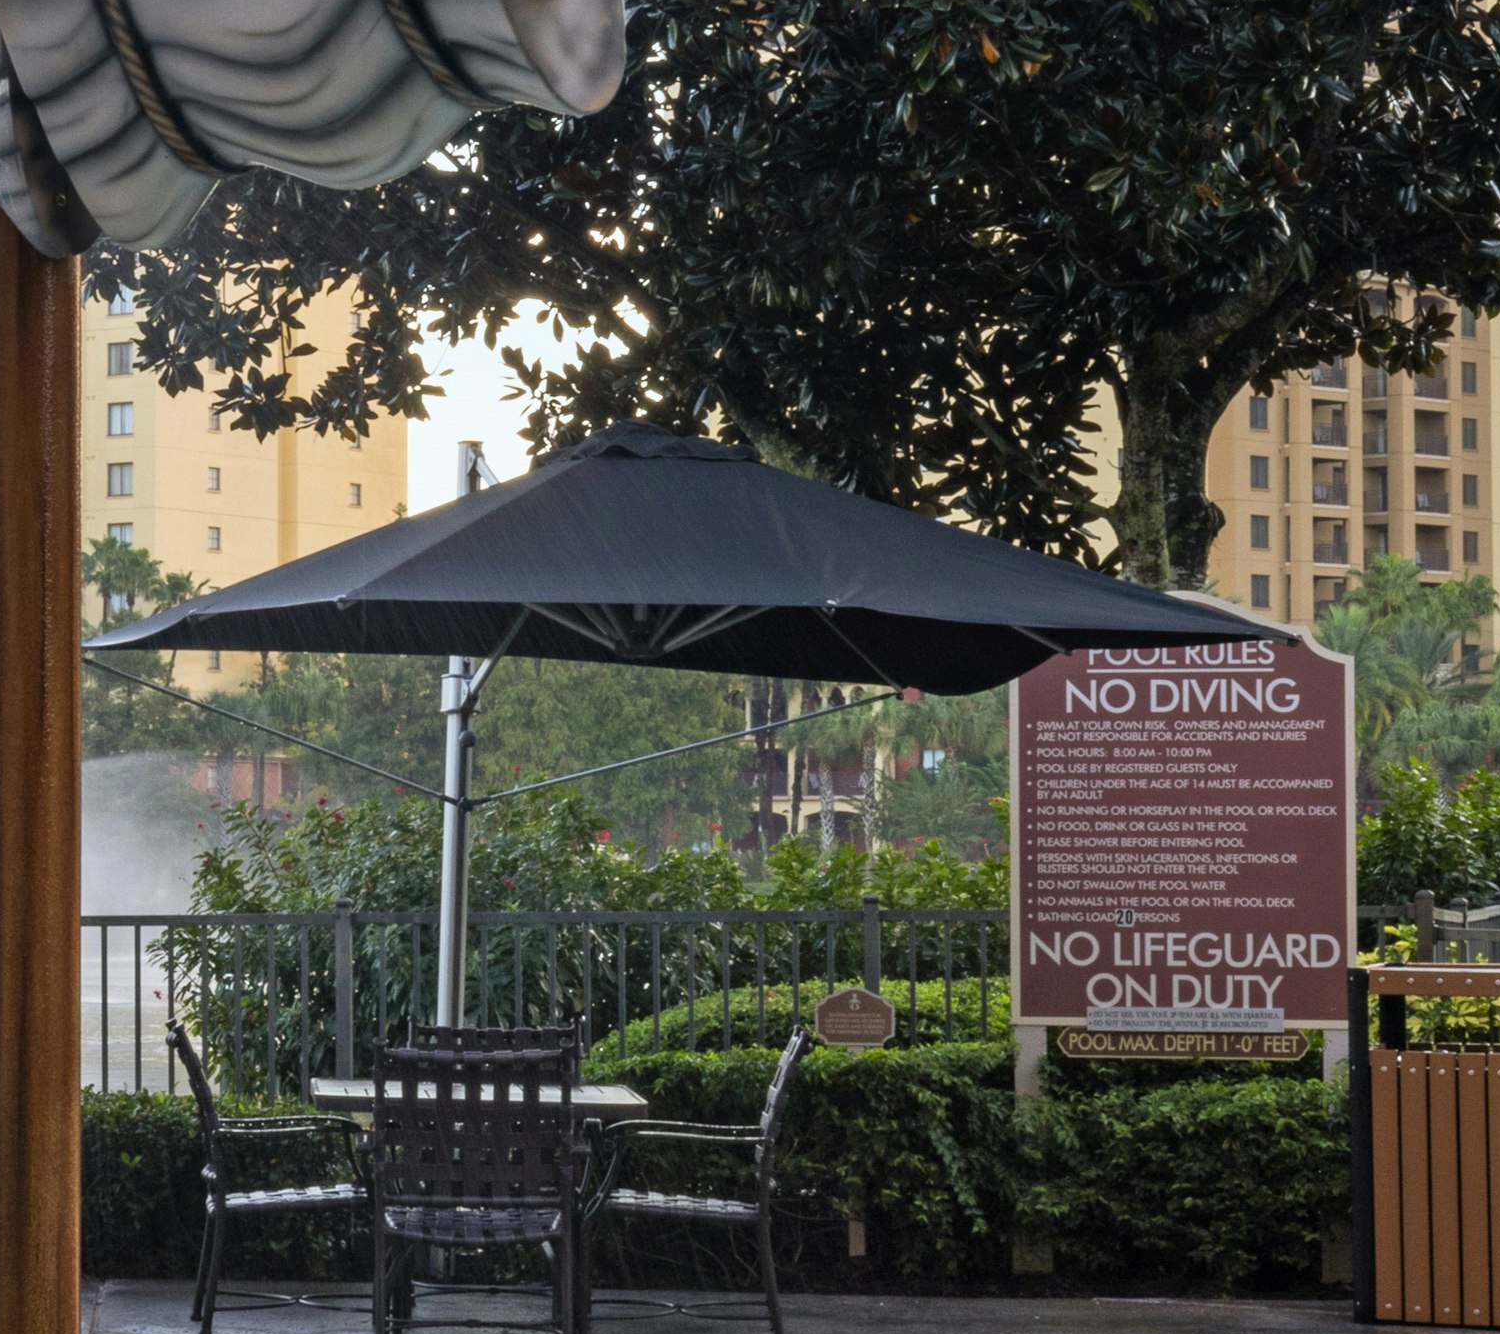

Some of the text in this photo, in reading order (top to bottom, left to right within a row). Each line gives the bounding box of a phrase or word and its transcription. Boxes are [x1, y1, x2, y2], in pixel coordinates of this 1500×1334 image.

[1088, 640, 1275, 665] POOL RULES
[1066, 677, 1300, 714] NO DIVING
[1037, 720, 1325, 730] SWIM AT YOUR OWN RISK. OWNERS AND MANAGEMENT
[1037, 732, 1307, 741] ARE NOT RESPONSIBLE FOR ACCIDENTS AND INJURIES
[1037, 748, 1065, 757] POOL
[1114, 748, 1136, 757] 8:00
[1139, 748, 1155, 757] AM
[1166, 748, 1194, 757] 10:00
[1196, 748, 1212, 757] PM
[1037, 763, 1238, 773] POOL USE BY REGISTERED GUESTS ONLY
[1037, 779, 1333, 789] CHILDREN UNDER THE AGE OF 14 MUST BE ACCOMPANIED
[1037, 790, 1103, 799] BY AN ADULT
[1037, 806, 1337, 815] NO RUNNING OR HORSEPLAY IN THE POOL OR POOL DECK
[1037, 822, 1248, 833] NO FOOD, DRINK OR GLASS IN THE POOL
[1037, 837, 1245, 847] PLEASE SHOWER BEFORE ENTERING POOL
[1037, 854, 1298, 864] PERSONS WITH SKIN LACERATIONS, INFECTIONS OR
[1037, 865, 1239, 875] BLISTERS SHOULD NOT ENTER THE POOL
[1037, 881, 1226, 891] DO NOT SWALLOW THE POOL WATER
[1038, 897, 1295, 907] NO ANIMALS IN THE POOL OR ON THE POOL DECK
[1038, 912, 1083, 922] BATHING
[1116, 910, 1133, 925] 20
[1029, 931, 1341, 968] NO LIFEGUARD
[1086, 973, 1284, 1009] ON DUTY
[1068, 1034, 1116, 1051] POOL
[1119, 1034, 1159, 1051] MAX.
[1164, 1034, 1216, 1052] DEPTH
[1263, 1035, 1299, 1053] FEET
